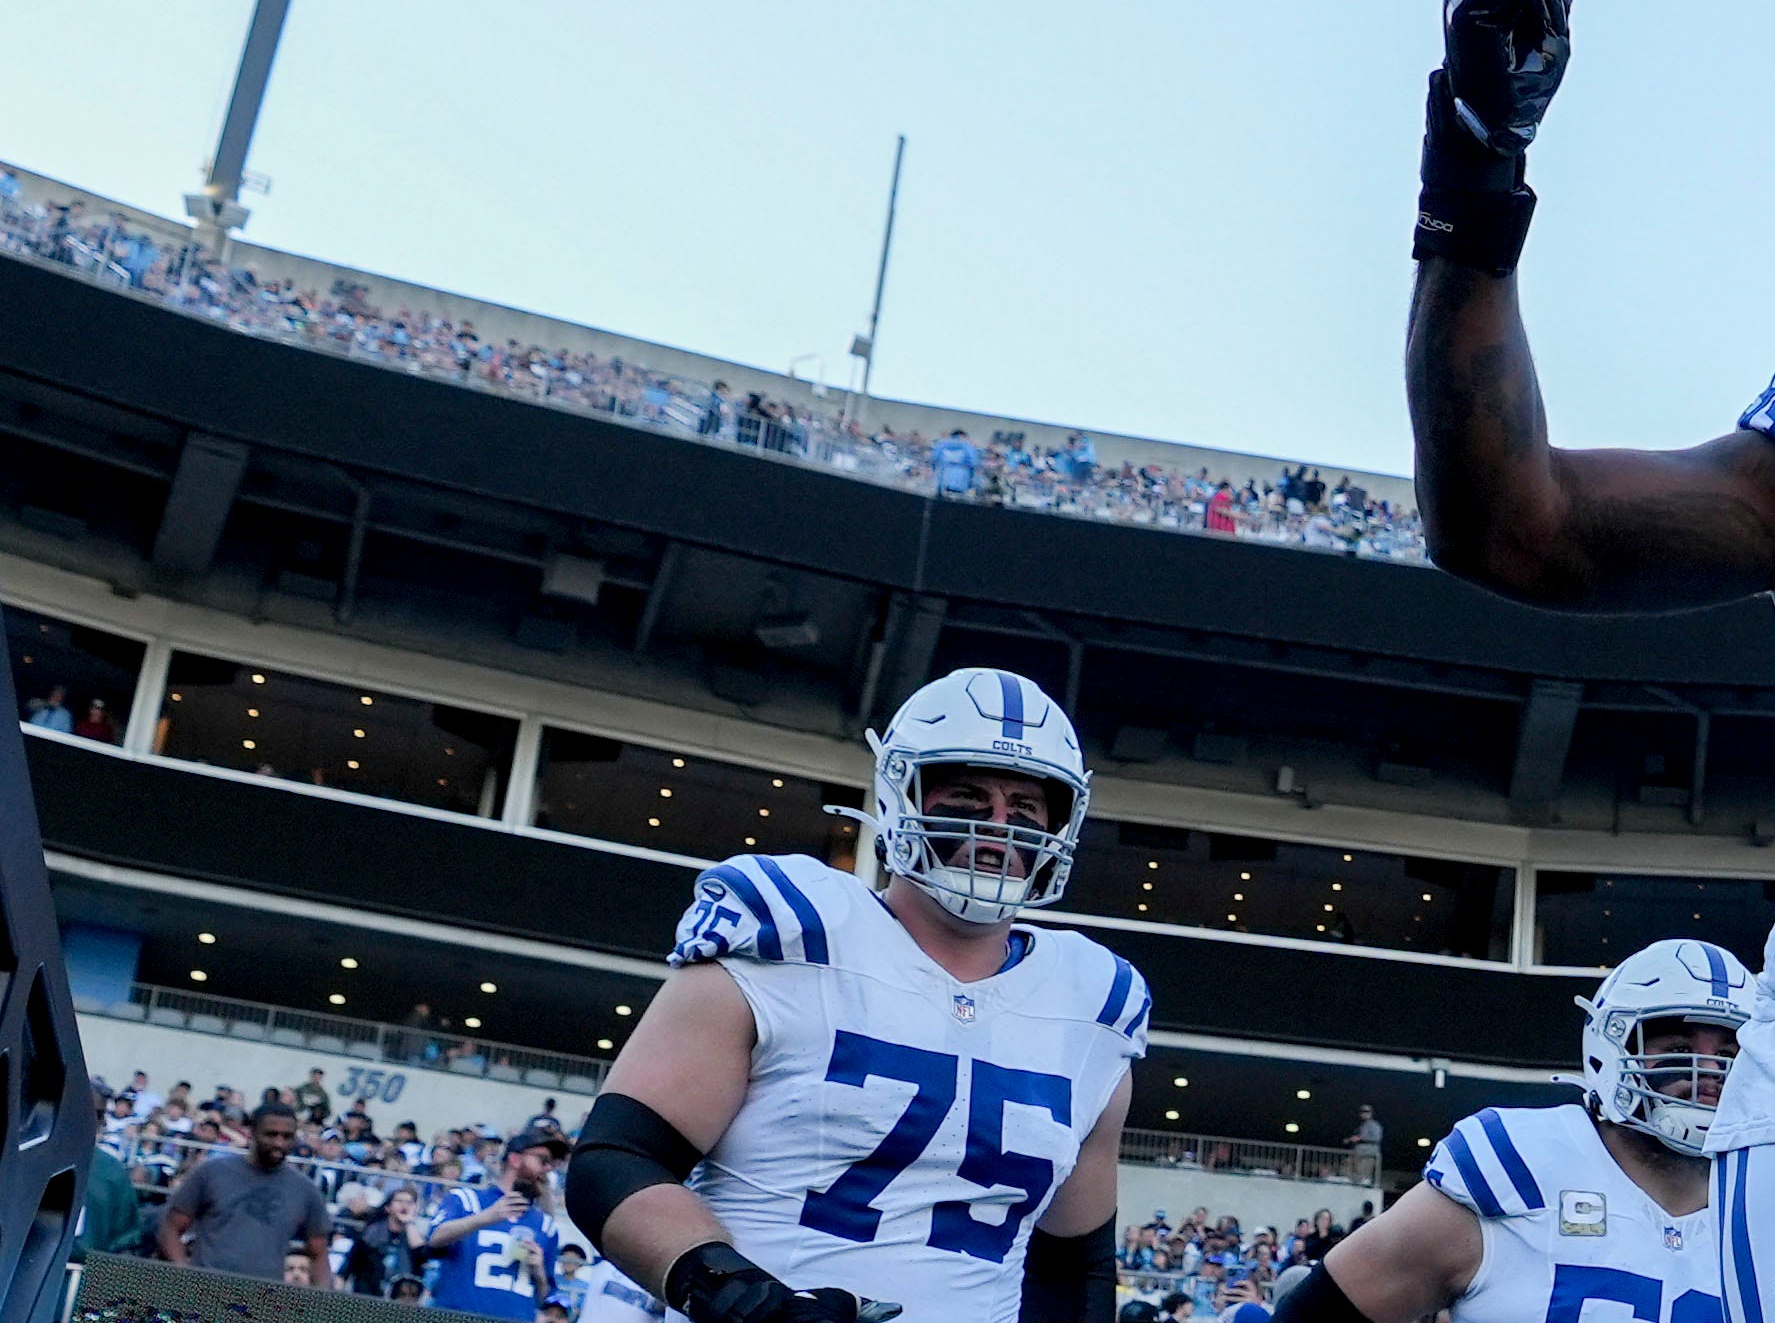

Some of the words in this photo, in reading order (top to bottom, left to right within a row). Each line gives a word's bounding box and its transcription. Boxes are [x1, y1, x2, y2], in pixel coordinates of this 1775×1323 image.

[992, 740, 1033, 756] COLTS
[670, 899, 742, 961] 75
[799, 1029, 1072, 1264] 75
[1563, 1191, 1606, 1225] C
